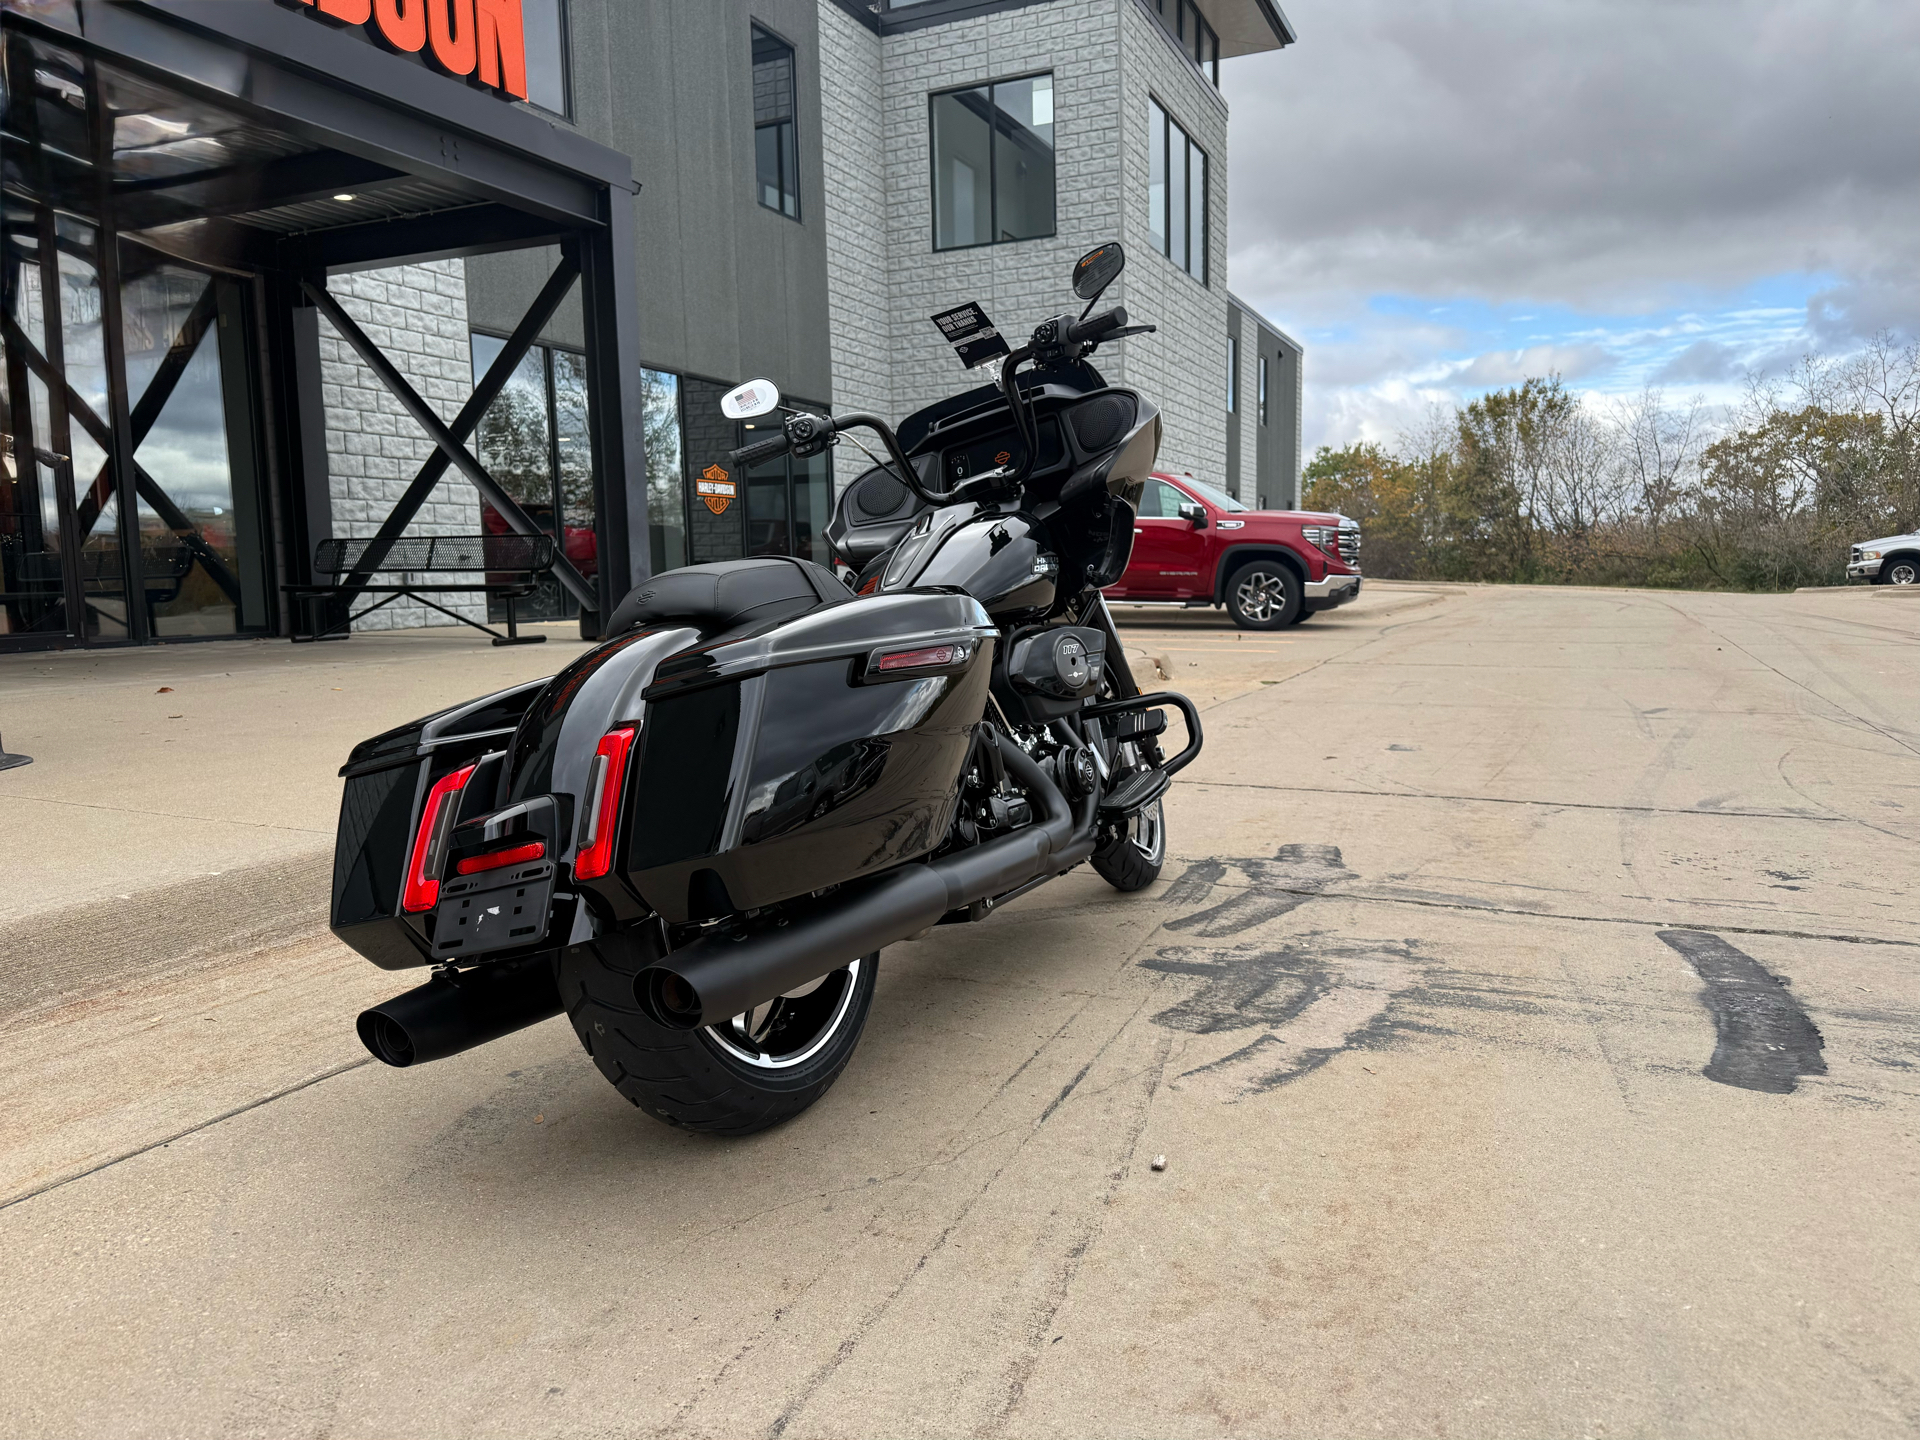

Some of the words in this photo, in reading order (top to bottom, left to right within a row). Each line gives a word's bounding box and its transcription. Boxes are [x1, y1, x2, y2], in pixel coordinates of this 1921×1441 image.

[936, 316, 953, 326] YOUR
[952, 308, 978, 321] SERVICE,
[942, 324, 956, 333] OUR
[954, 316, 977, 329] THANKS
[706, 468, 727, 480] MOTOR
[698, 482, 734, 495] HARLEY-DAVIDSON
[707, 498, 727, 510] CYCLES
[1063, 644, 1079, 655] 117
